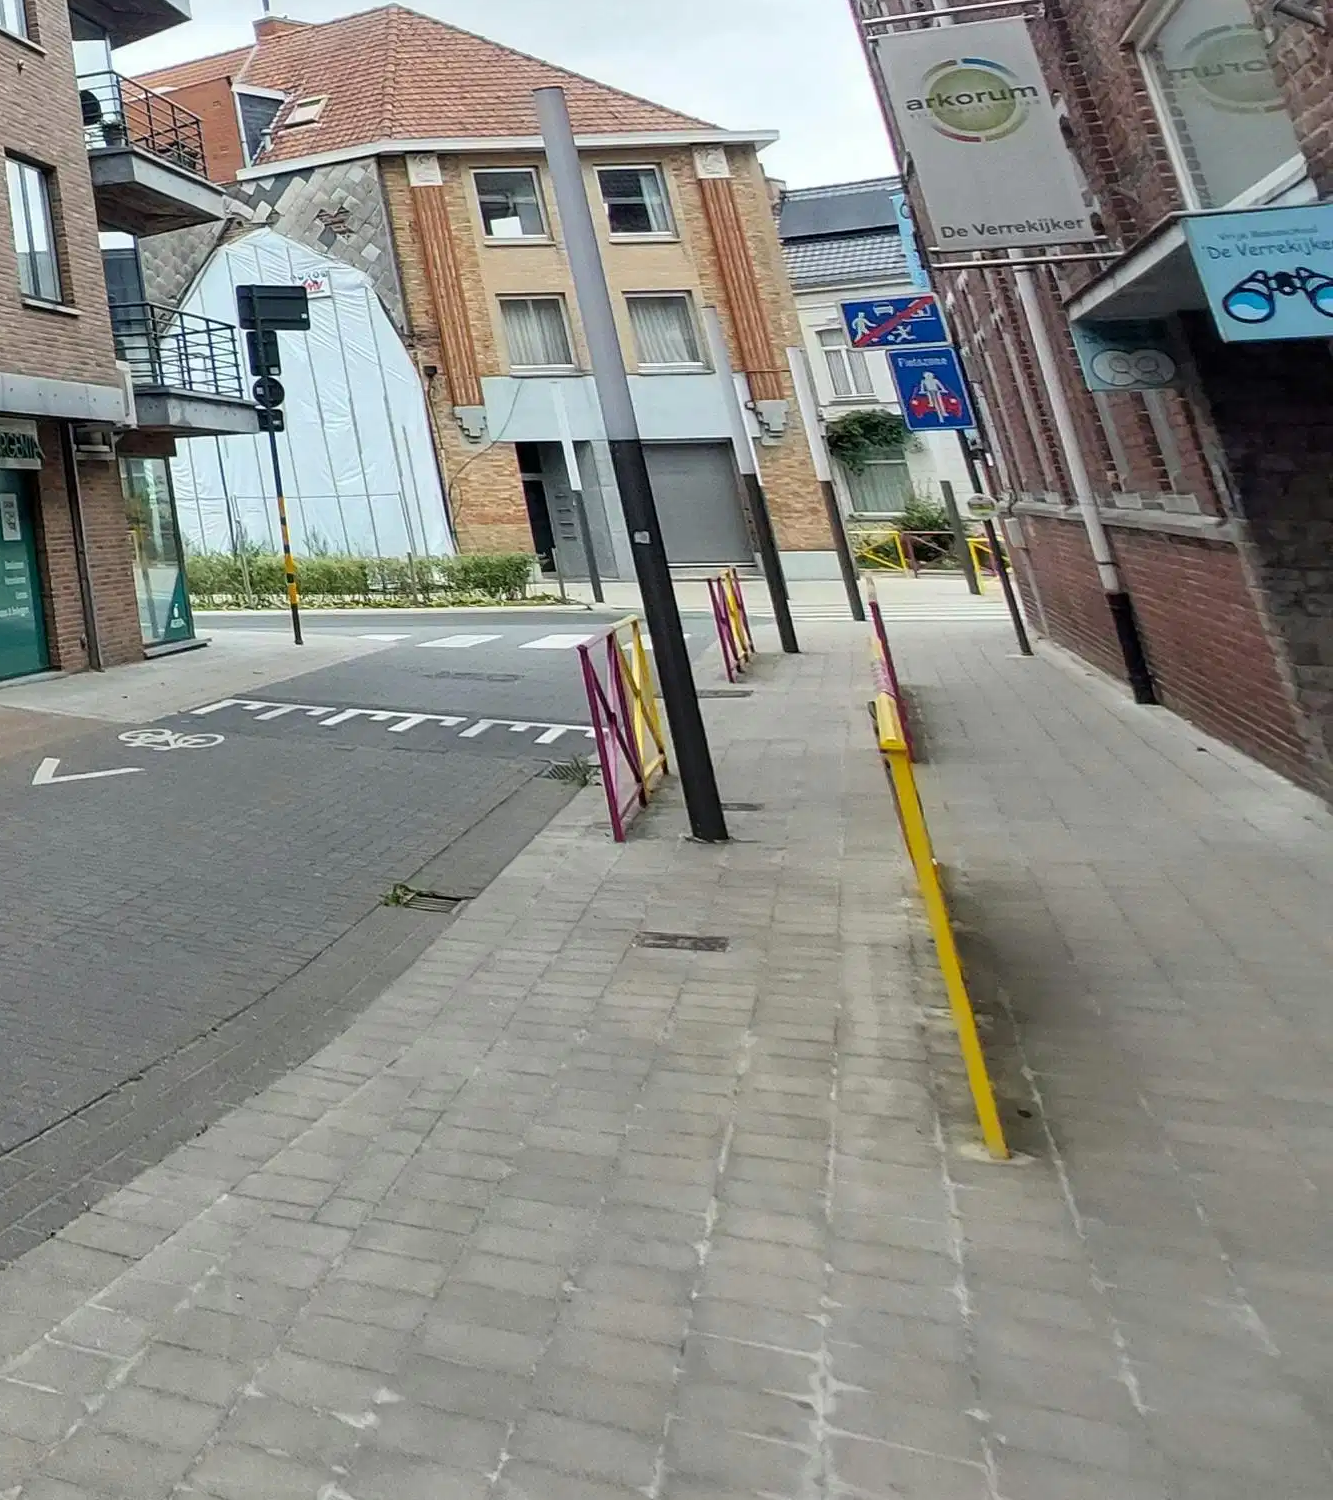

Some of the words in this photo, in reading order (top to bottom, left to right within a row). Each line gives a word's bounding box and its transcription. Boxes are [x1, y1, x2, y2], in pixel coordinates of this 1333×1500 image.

[906, 85, 1039, 111] arkorum
[941, 226, 968, 238] De
[972, 217, 1084, 236] Verrekijker
[1235, 237, 1333, 256] Verrekijke
